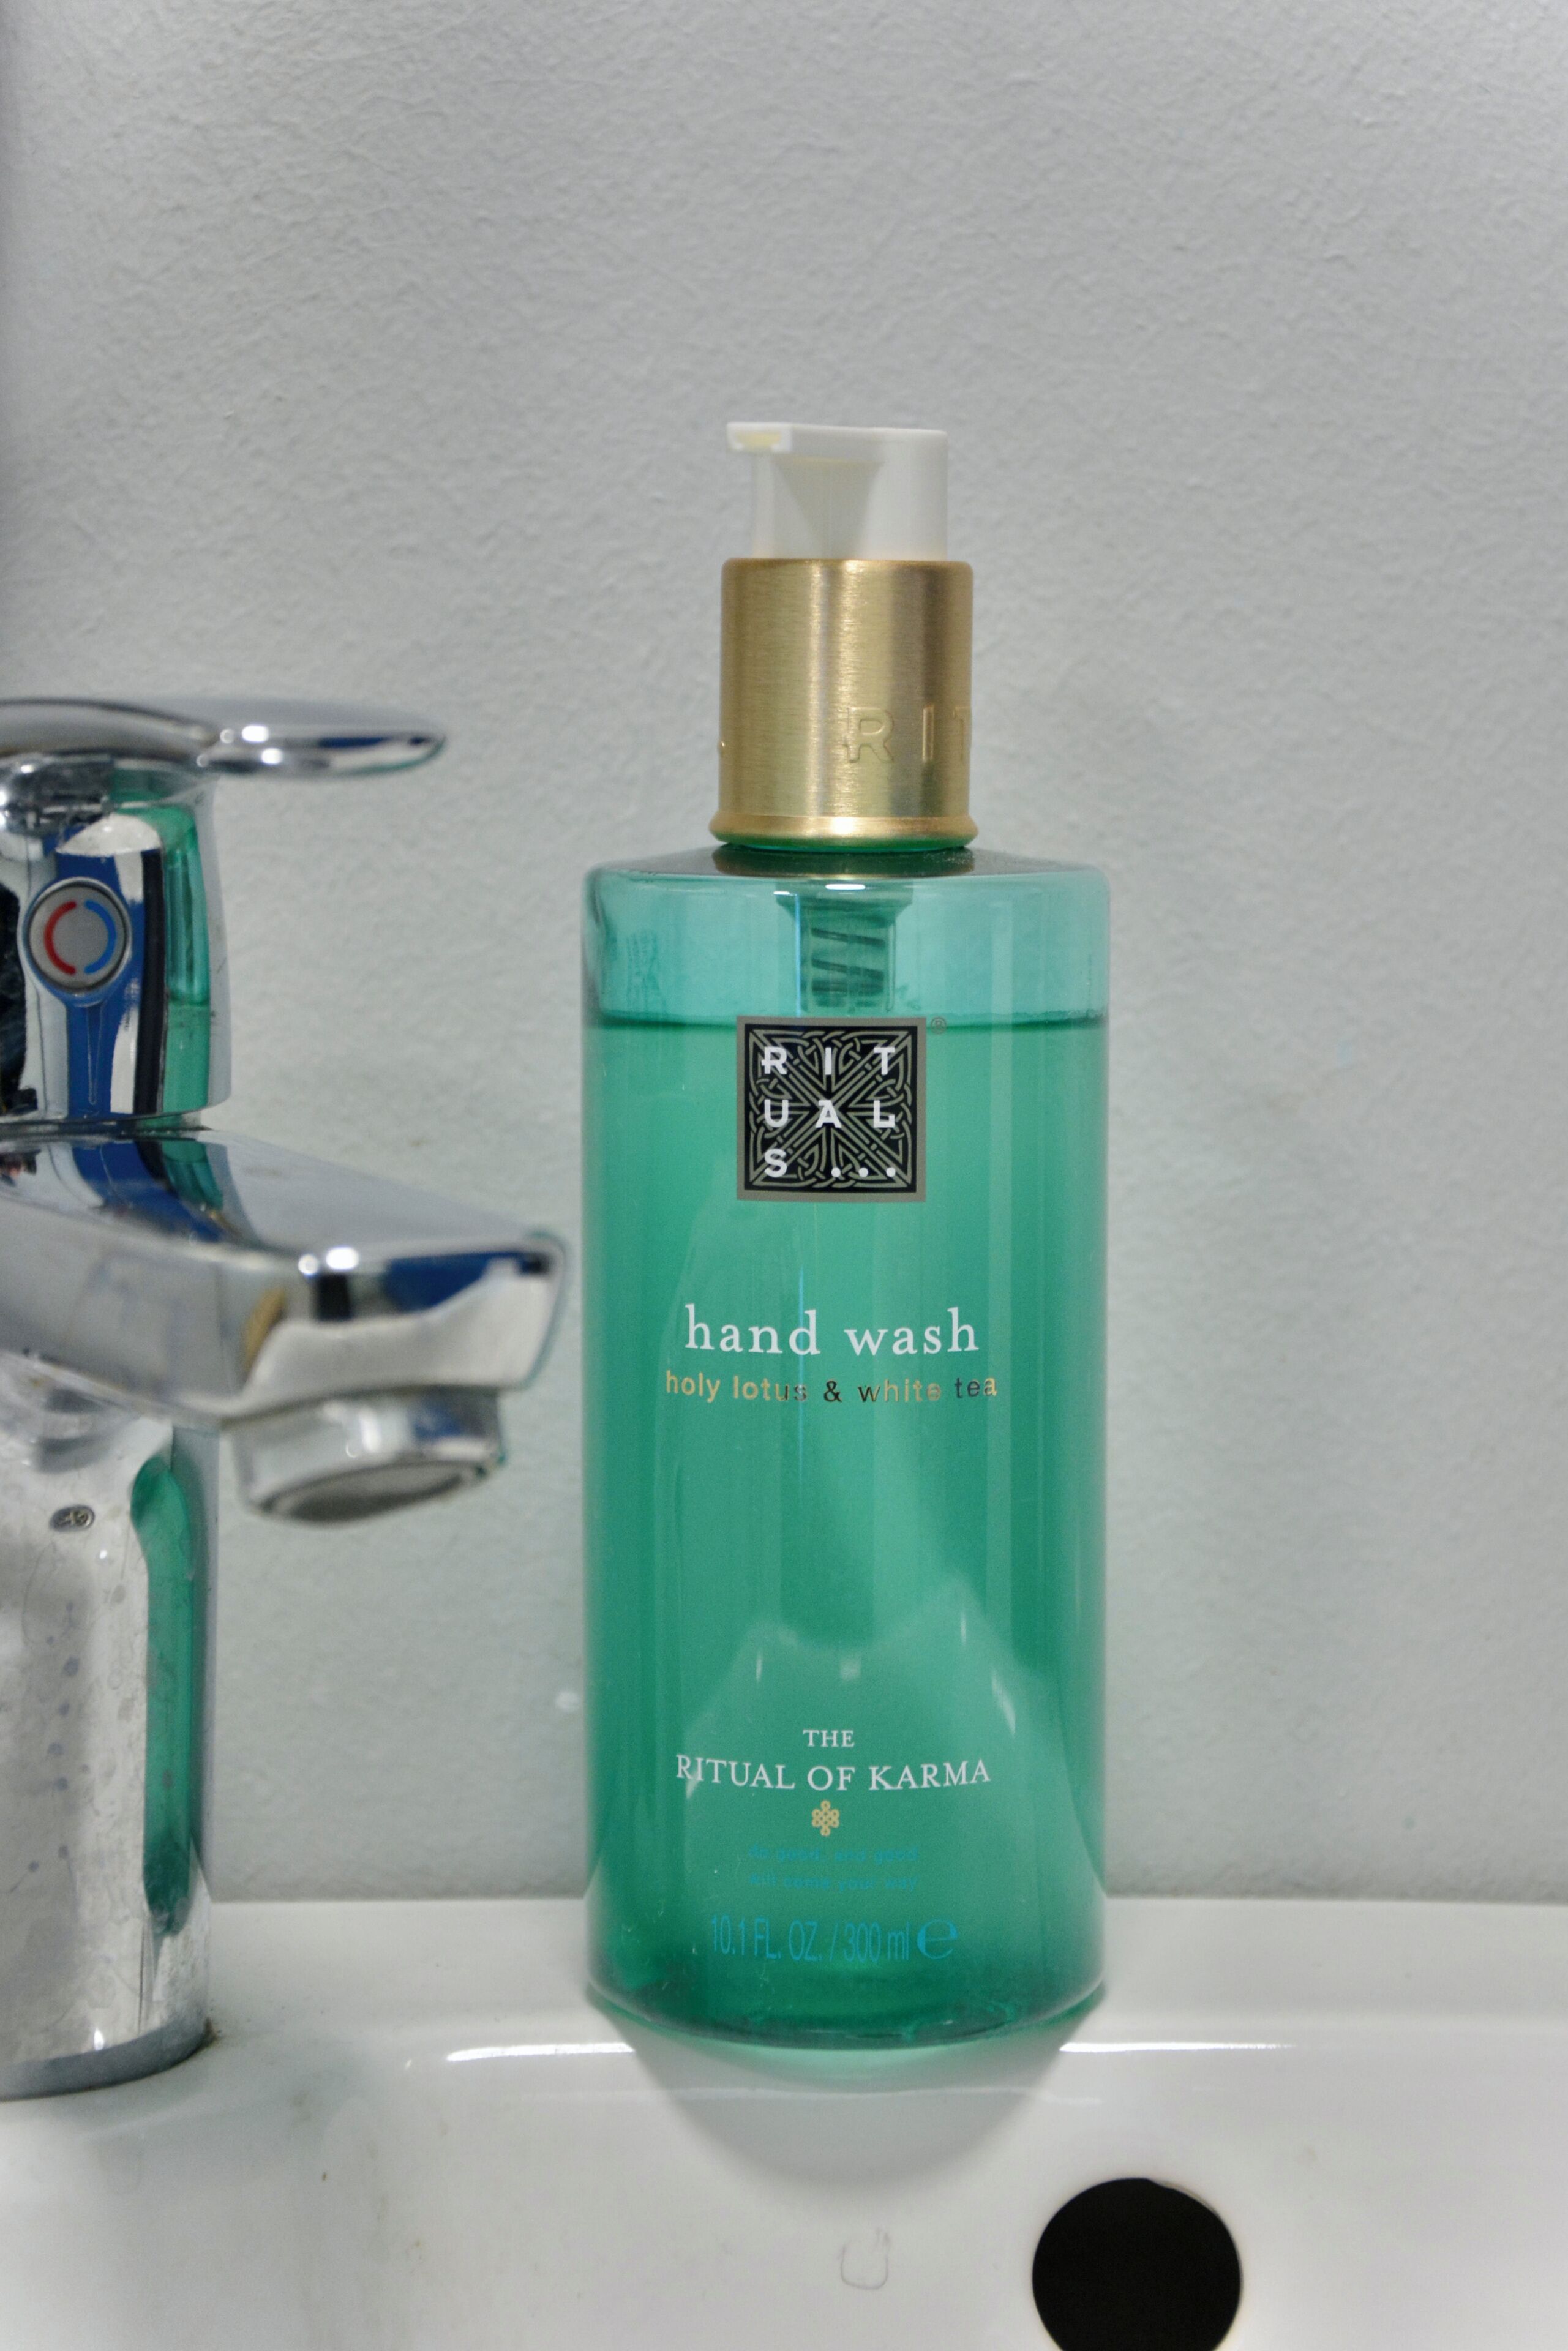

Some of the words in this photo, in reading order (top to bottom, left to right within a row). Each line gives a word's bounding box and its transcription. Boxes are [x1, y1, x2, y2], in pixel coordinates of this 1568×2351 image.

[685, 1303, 821, 1356] hand
[844, 1306, 979, 1357] wash
[666, 1369, 721, 1403] holy
[733, 1374, 808, 1401] lotus
[823, 1379, 842, 1402] &
[857, 1378, 942, 1403] white
[955, 1376, 997, 1399] tea
[803, 1729, 855, 1748] THE
[676, 1755, 795, 1790] RITUAL
[807, 1766, 855, 1791] OF
[868, 1758, 991, 1791] KARMA
[843, 1920, 882, 1963] 300
[888, 1921, 910, 1961] ml
